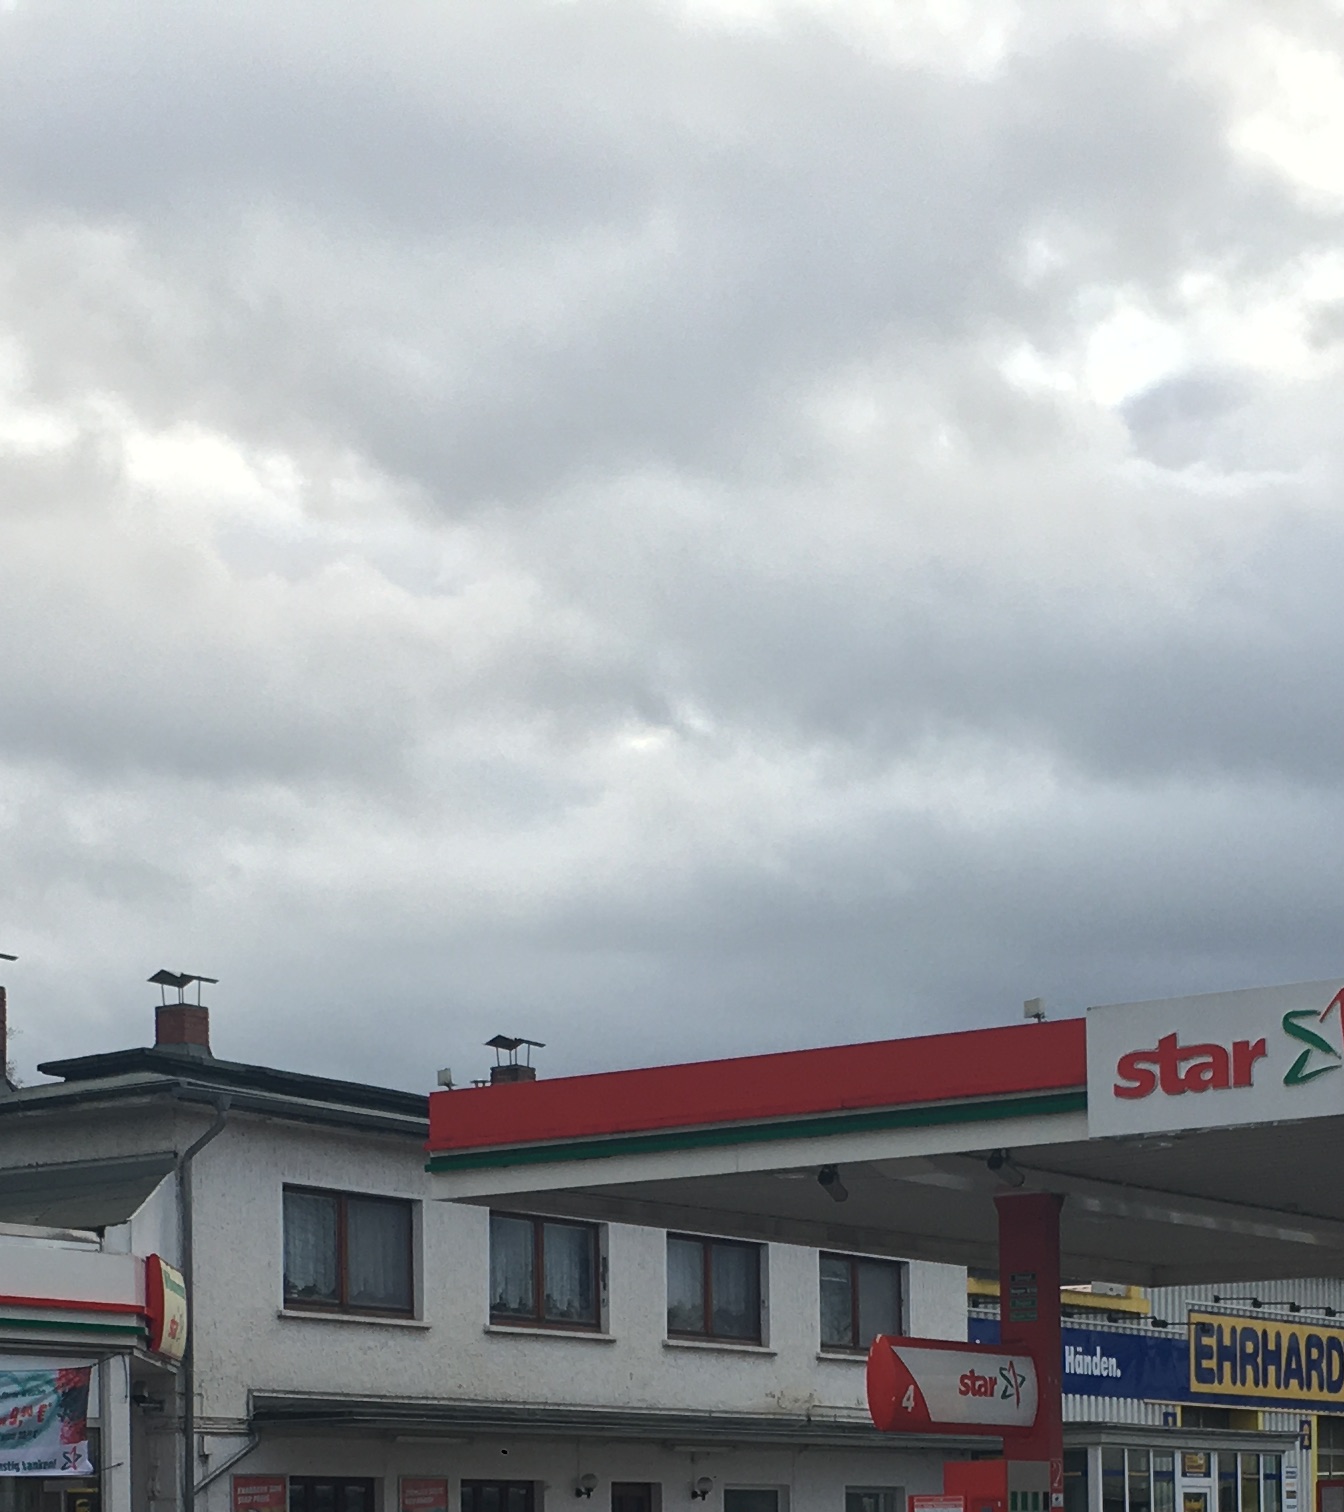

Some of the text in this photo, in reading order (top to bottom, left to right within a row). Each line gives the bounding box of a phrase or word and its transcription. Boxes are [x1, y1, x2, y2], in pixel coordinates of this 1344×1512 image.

[1113, 1032, 1268, 1099] star
[1064, 1344, 1122, 1378] Händen.
[902, 1384, 915, 1412] 4
[958, 1368, 997, 1398] star
